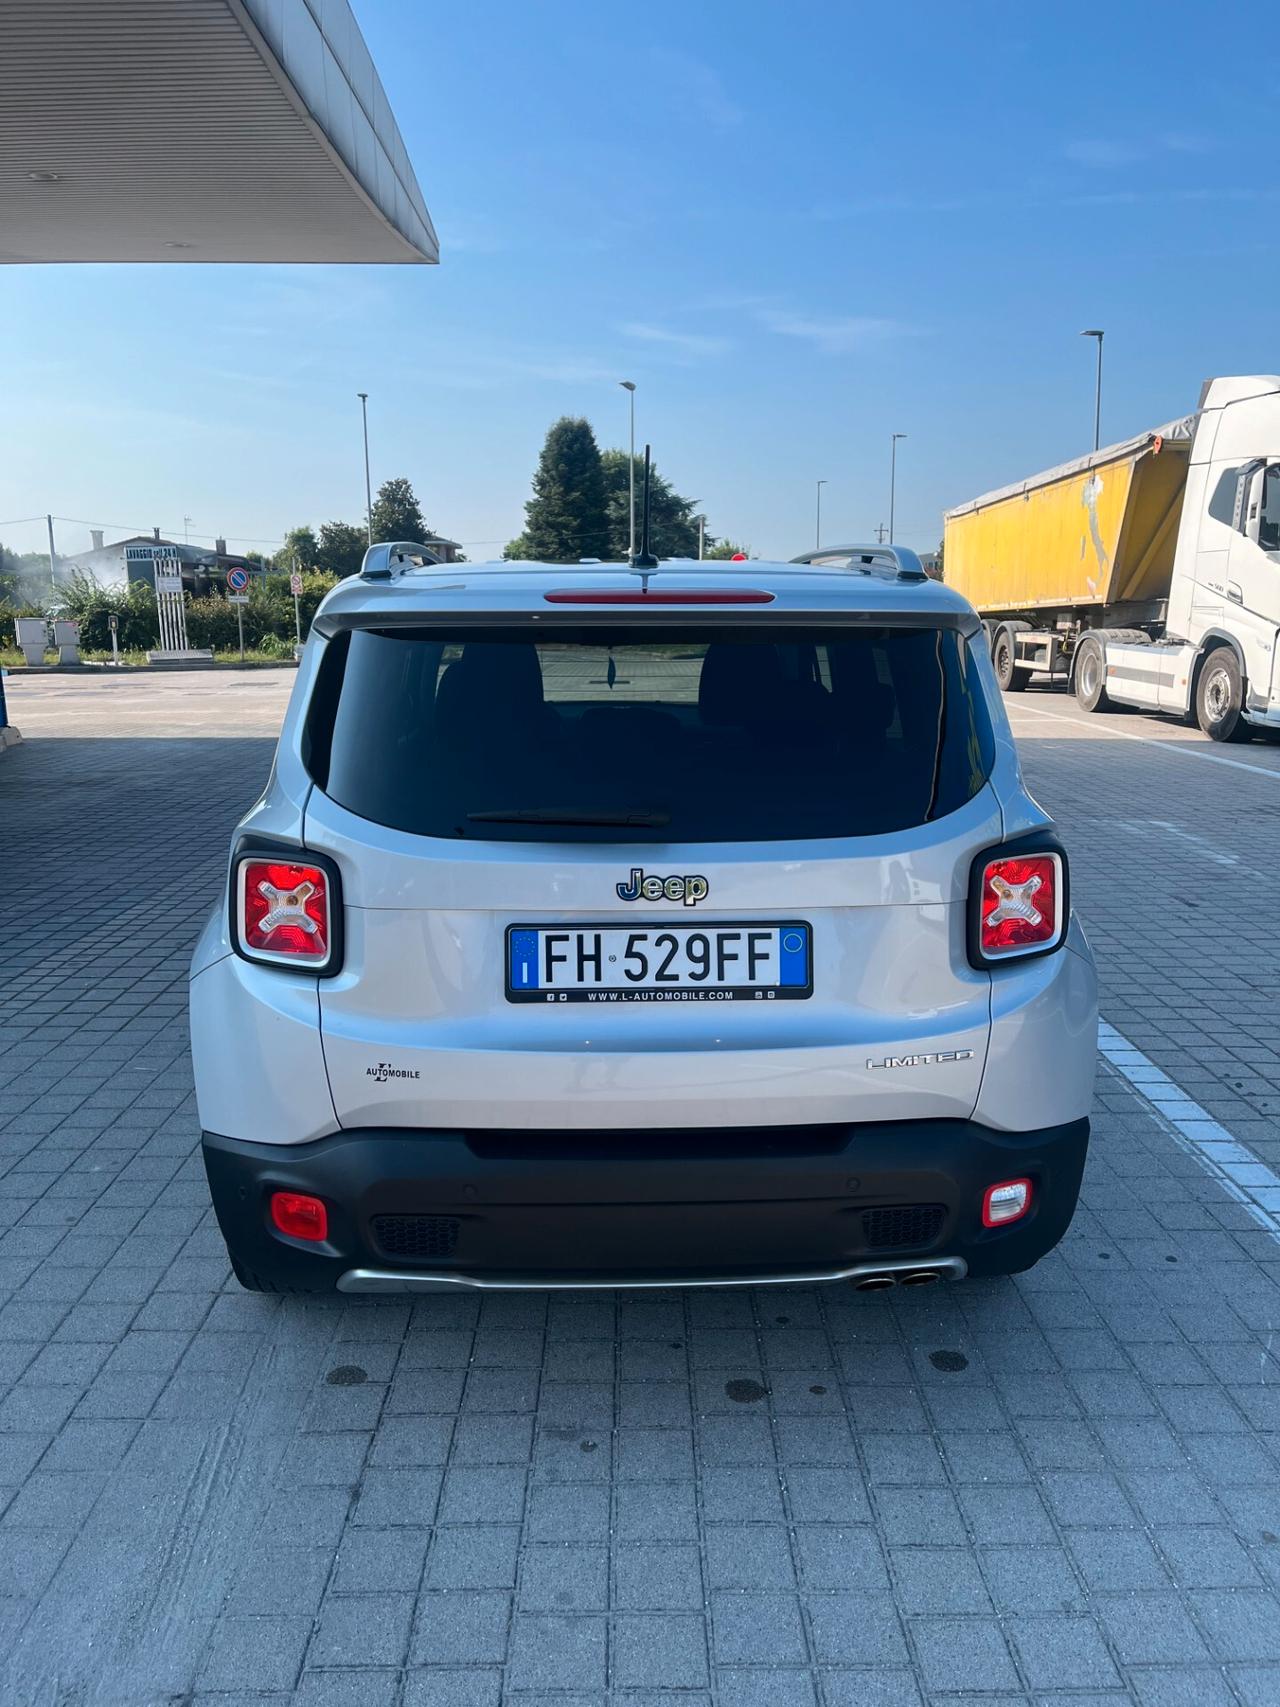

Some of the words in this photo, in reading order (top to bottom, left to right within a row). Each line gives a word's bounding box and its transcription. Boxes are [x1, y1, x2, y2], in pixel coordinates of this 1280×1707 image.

[616, 868, 709, 906] Jeep
[545, 933, 602, 983] FH
[624, 932, 773, 982] 529FF
[522, 962, 528, 983] I
[588, 991, 733, 1001] WWW.L-AUTOMOBILE.COM
[866, 1049, 975, 1069] LIMITED
[366, 1067, 420, 1079] AUTOMOBILE
